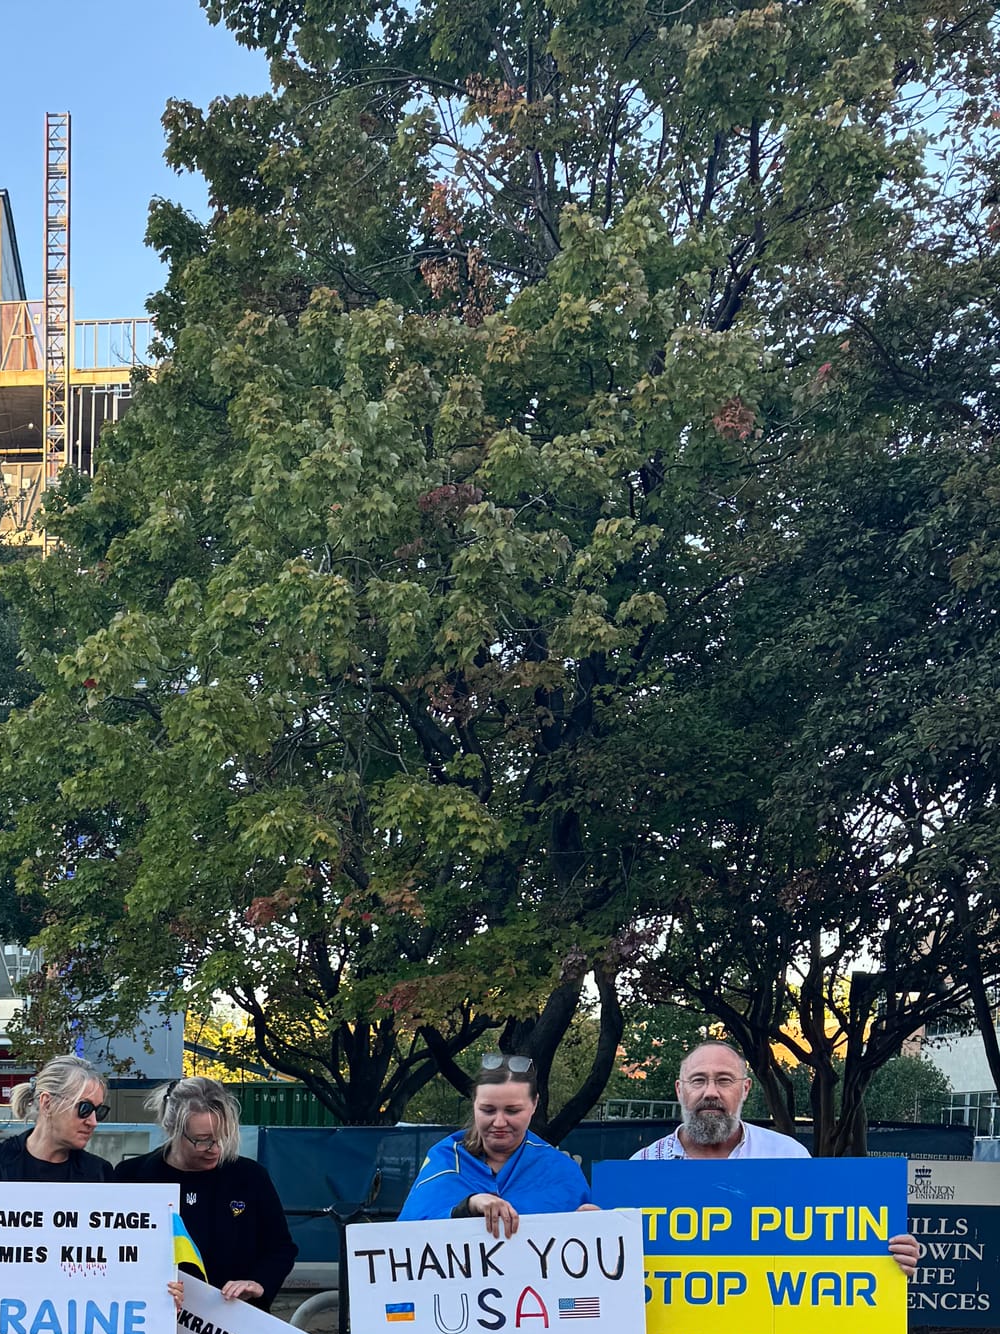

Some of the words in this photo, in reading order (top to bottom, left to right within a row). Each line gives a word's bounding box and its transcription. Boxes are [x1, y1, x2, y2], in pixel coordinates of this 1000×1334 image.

[53, 1212, 78, 1228] ON
[89, 1212, 157, 1229] STAGE.
[641, 1206, 732, 1241] TOP
[751, 1206, 889, 1241] PUTIN
[907, 1217, 968, 1236] ILLS
[61, 1246, 107, 1263] KILL
[119, 1246, 138, 1262] IN
[354, 1241, 505, 1284] THANK
[527, 1235, 625, 1280] YOU
[908, 1267, 955, 1285] IFE
[767, 1271, 877, 1306] WAR
[433, 1285, 549, 1334] USA
[907, 1292, 990, 1311] ENCES
